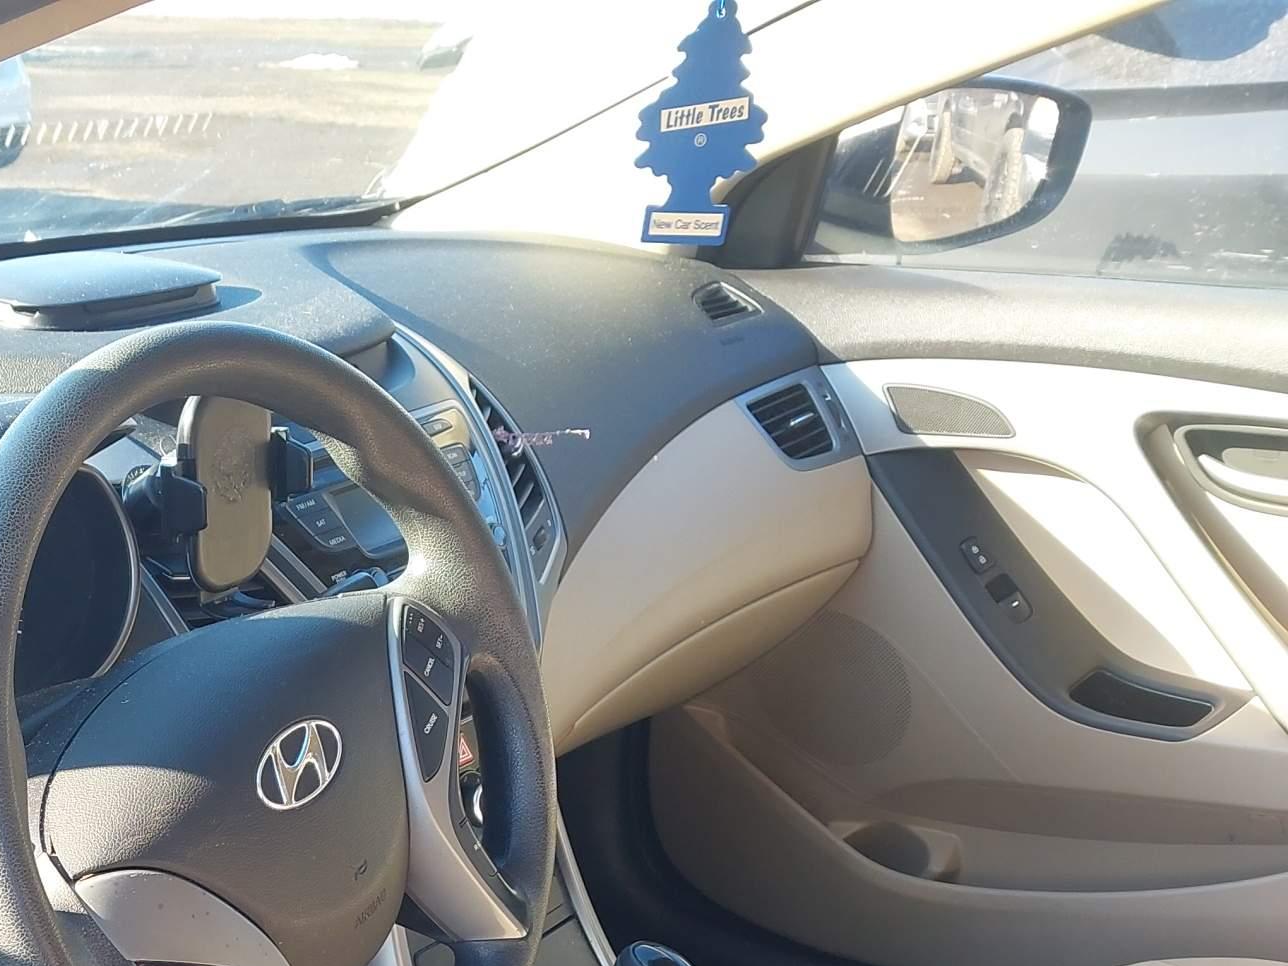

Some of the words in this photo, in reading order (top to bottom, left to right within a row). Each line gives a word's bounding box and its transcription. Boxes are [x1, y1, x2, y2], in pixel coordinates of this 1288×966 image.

[666, 107, 704, 129] Little
[708, 104, 745, 122] Trees
[653, 218, 672, 230] New
[675, 218, 692, 230] Car
[693, 218, 720, 231] Scent
